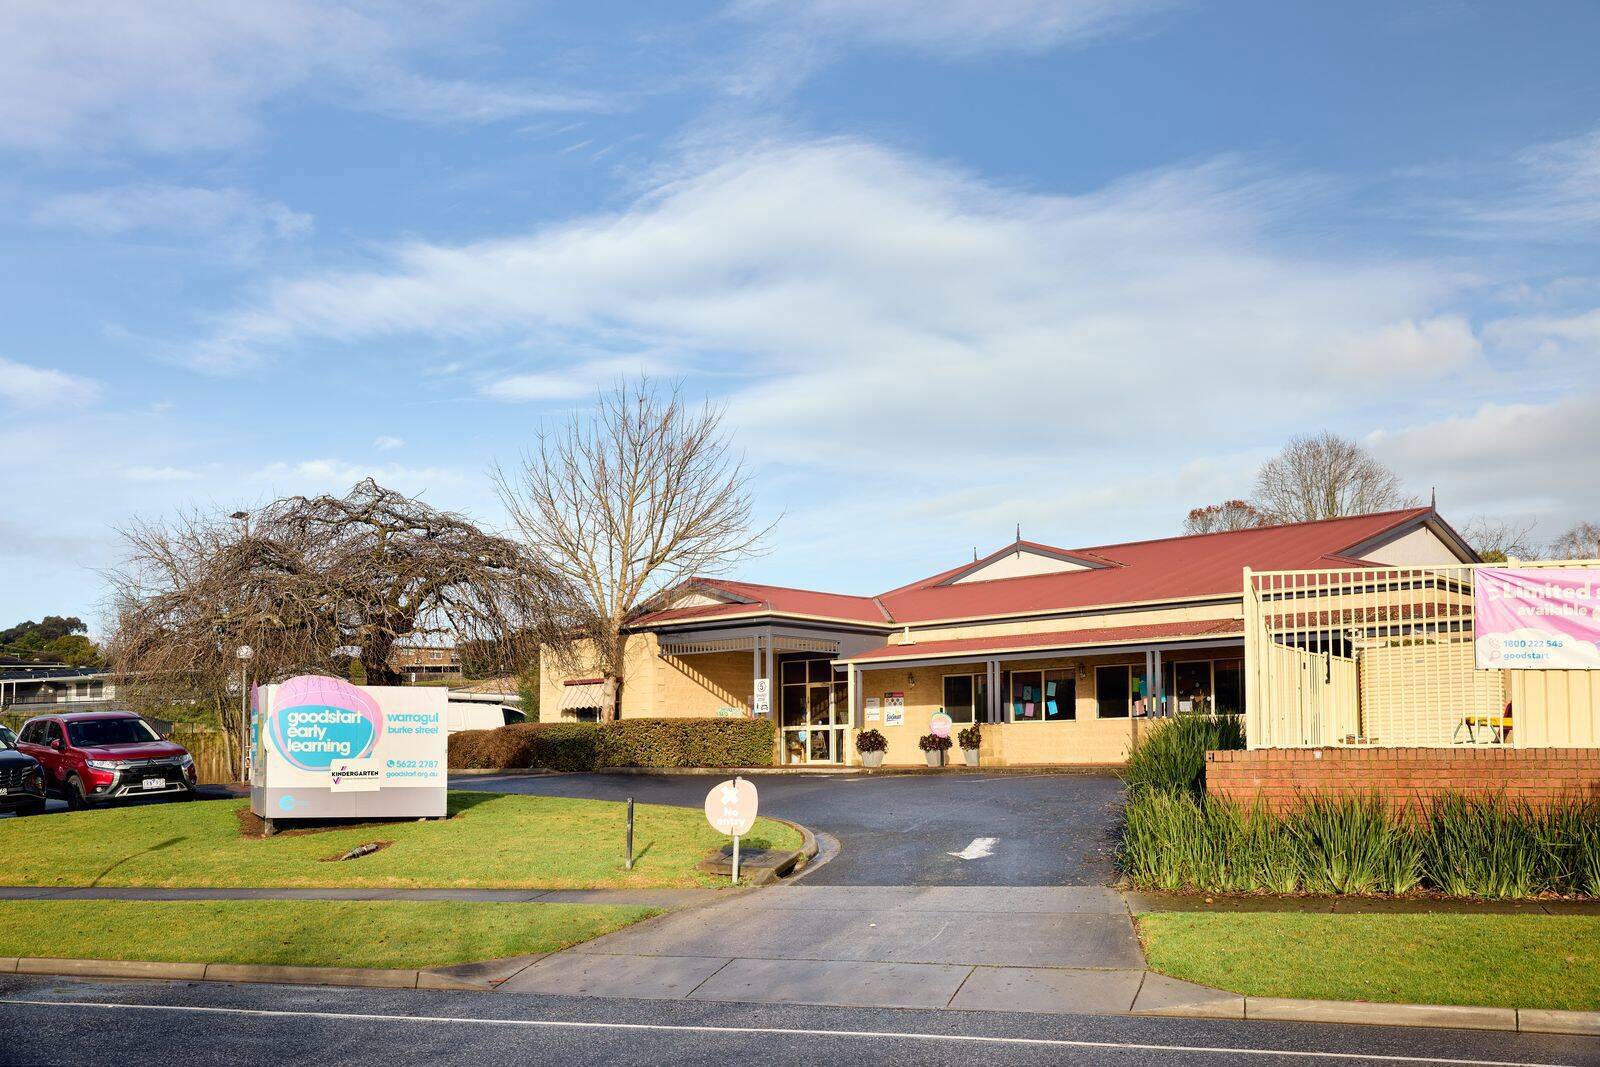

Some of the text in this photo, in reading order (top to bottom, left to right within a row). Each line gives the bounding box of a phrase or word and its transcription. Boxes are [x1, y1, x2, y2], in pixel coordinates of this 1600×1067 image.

[1503, 581, 1592, 600] Limited
[1519, 603, 1588, 616] available
[1503, 640, 1527, 648] 1800
[1528, 640, 1544, 648] 222
[1503, 651, 1550, 661] goodstart
[287, 711, 362, 725] goodstart
[387, 713, 439, 725] warragul
[287, 725, 327, 738] early
[287, 739, 351, 755] learning
[396, 760, 439, 768] 5622 2787
[386, 771, 438, 779] goodstart.org.au
[716, 819, 746, 829] entry
